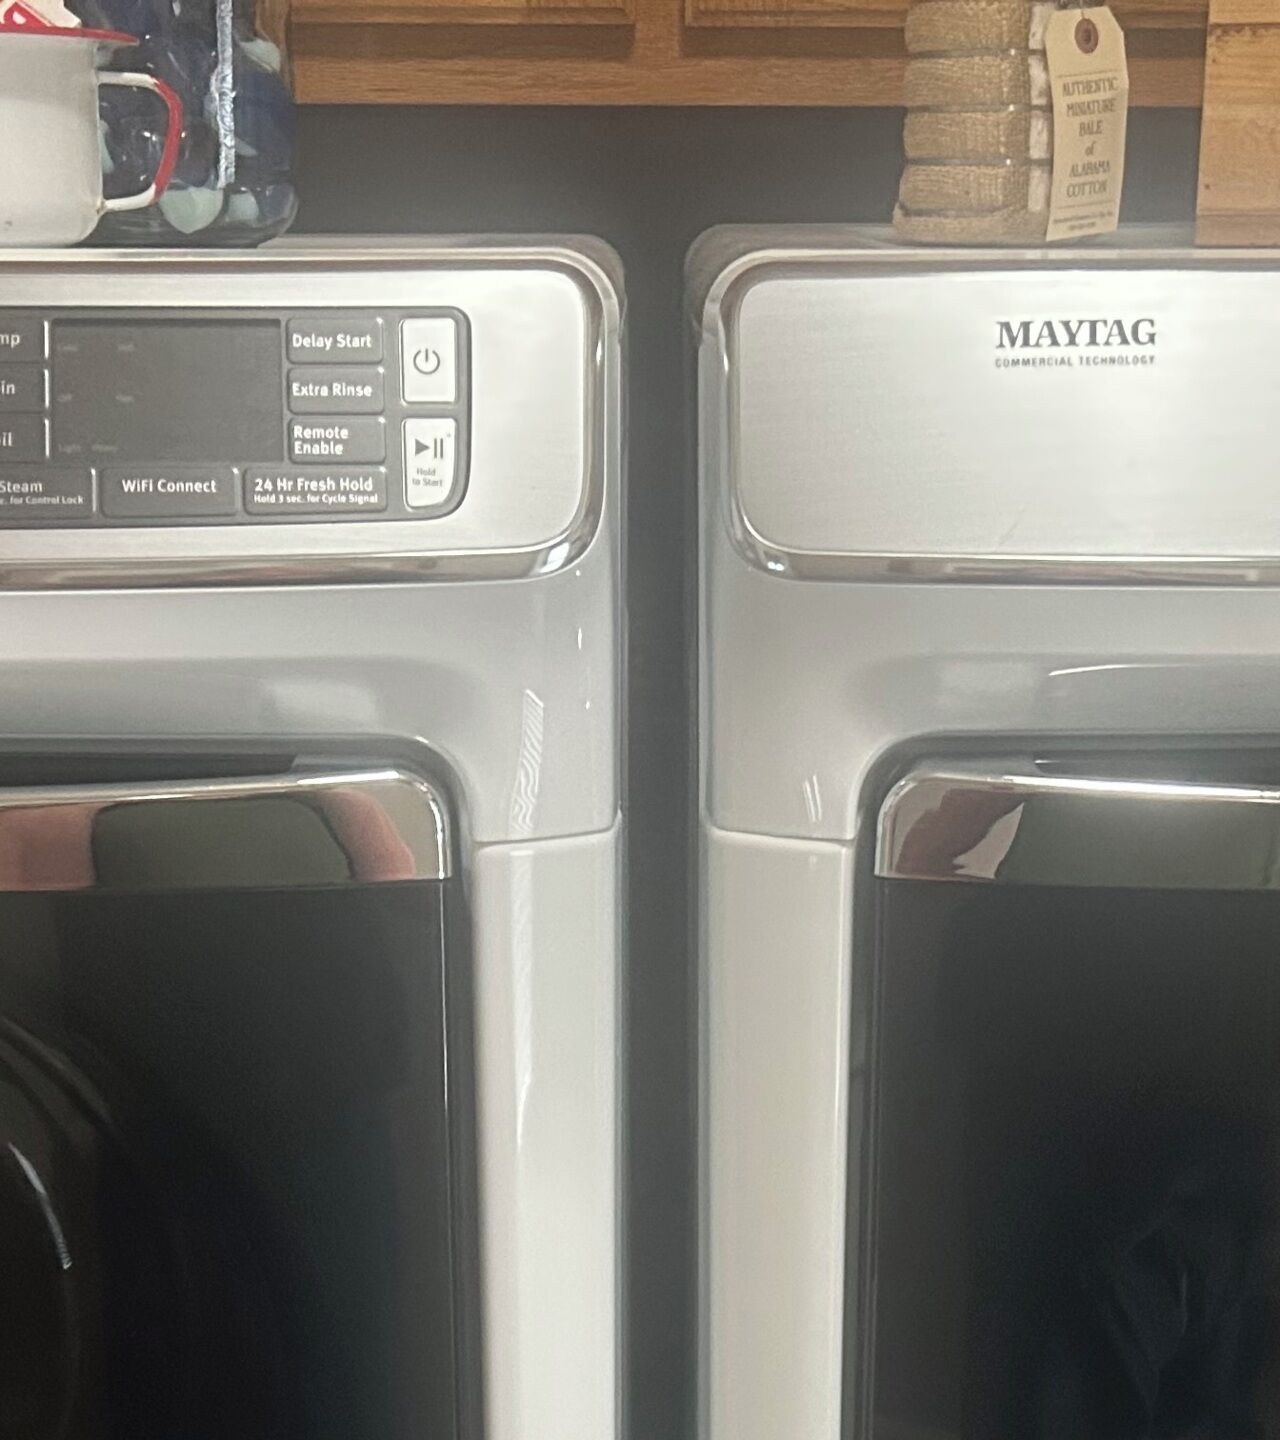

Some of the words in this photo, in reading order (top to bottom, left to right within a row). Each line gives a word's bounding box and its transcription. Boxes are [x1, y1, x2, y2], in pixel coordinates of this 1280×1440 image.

[1062, 79, 1118, 96] AUTHENTIC
[1067, 99, 1116, 117] MINIATURE
[1079, 121, 1102, 136] BALE
[1070, 161, 1111, 177] ALABAMA
[1066, 182, 1107, 198] COTTON
[995, 318, 1157, 349] MAYTAG
[293, 333, 333, 351] Delay
[337, 333, 371, 348] Start
[995, 356, 1073, 368] COMMERCIAL
[1079, 355, 1155, 366] TECHNOLOGY
[292, 382, 329, 397] Extra
[333, 382, 372, 397] Rinse
[294, 426, 349, 440] Remote
[295, 441, 343, 455] Enable
[417, 468, 436, 476] Hold
[122, 479, 154, 493] WiFi
[158, 479, 216, 493] Connect
[255, 479, 273, 492] 24
[277, 478, 293, 492] Hr
[297, 478, 336, 492] Fresh
[340, 478, 373, 492] Hold
[412, 478, 422, 486] to
[425, 477, 443, 486] Start
[28, 496, 60, 505] Control
[63, 496, 84, 505] Lock
[254, 494, 275, 503] Hold
[307, 494, 320, 503] for
[323, 494, 347, 506] Cycle
[350, 494, 378, 506] Signal
